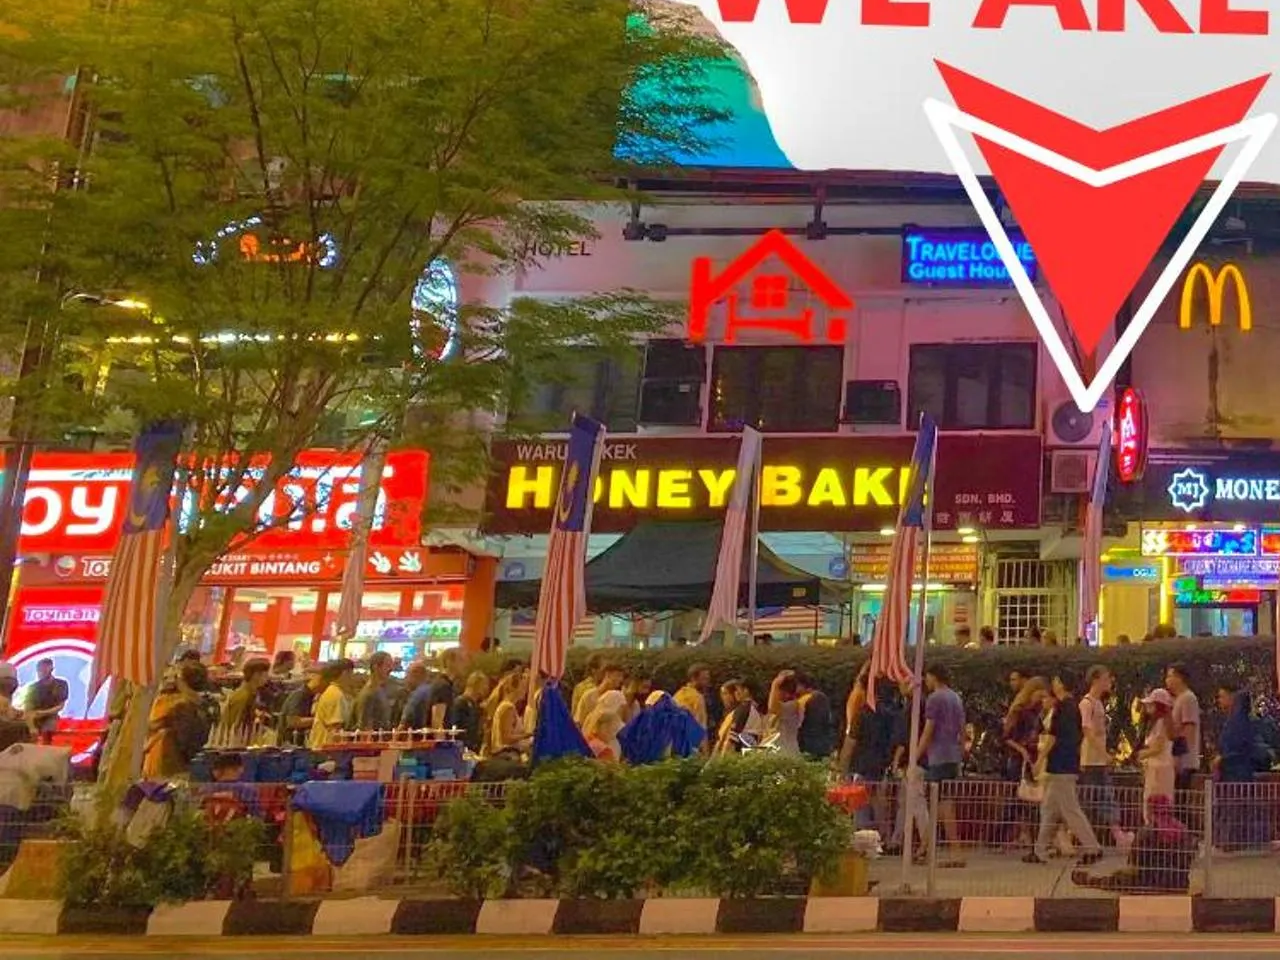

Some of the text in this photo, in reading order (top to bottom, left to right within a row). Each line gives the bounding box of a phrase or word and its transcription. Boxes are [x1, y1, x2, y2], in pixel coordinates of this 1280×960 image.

[906, 235, 1034, 262] TRAVELOE
[908, 262, 965, 280] Guest
[516, 443, 638, 460] WARU KEK
[506, 466, 737, 509] HNEY
[250, 561, 321, 575] BINTANG
